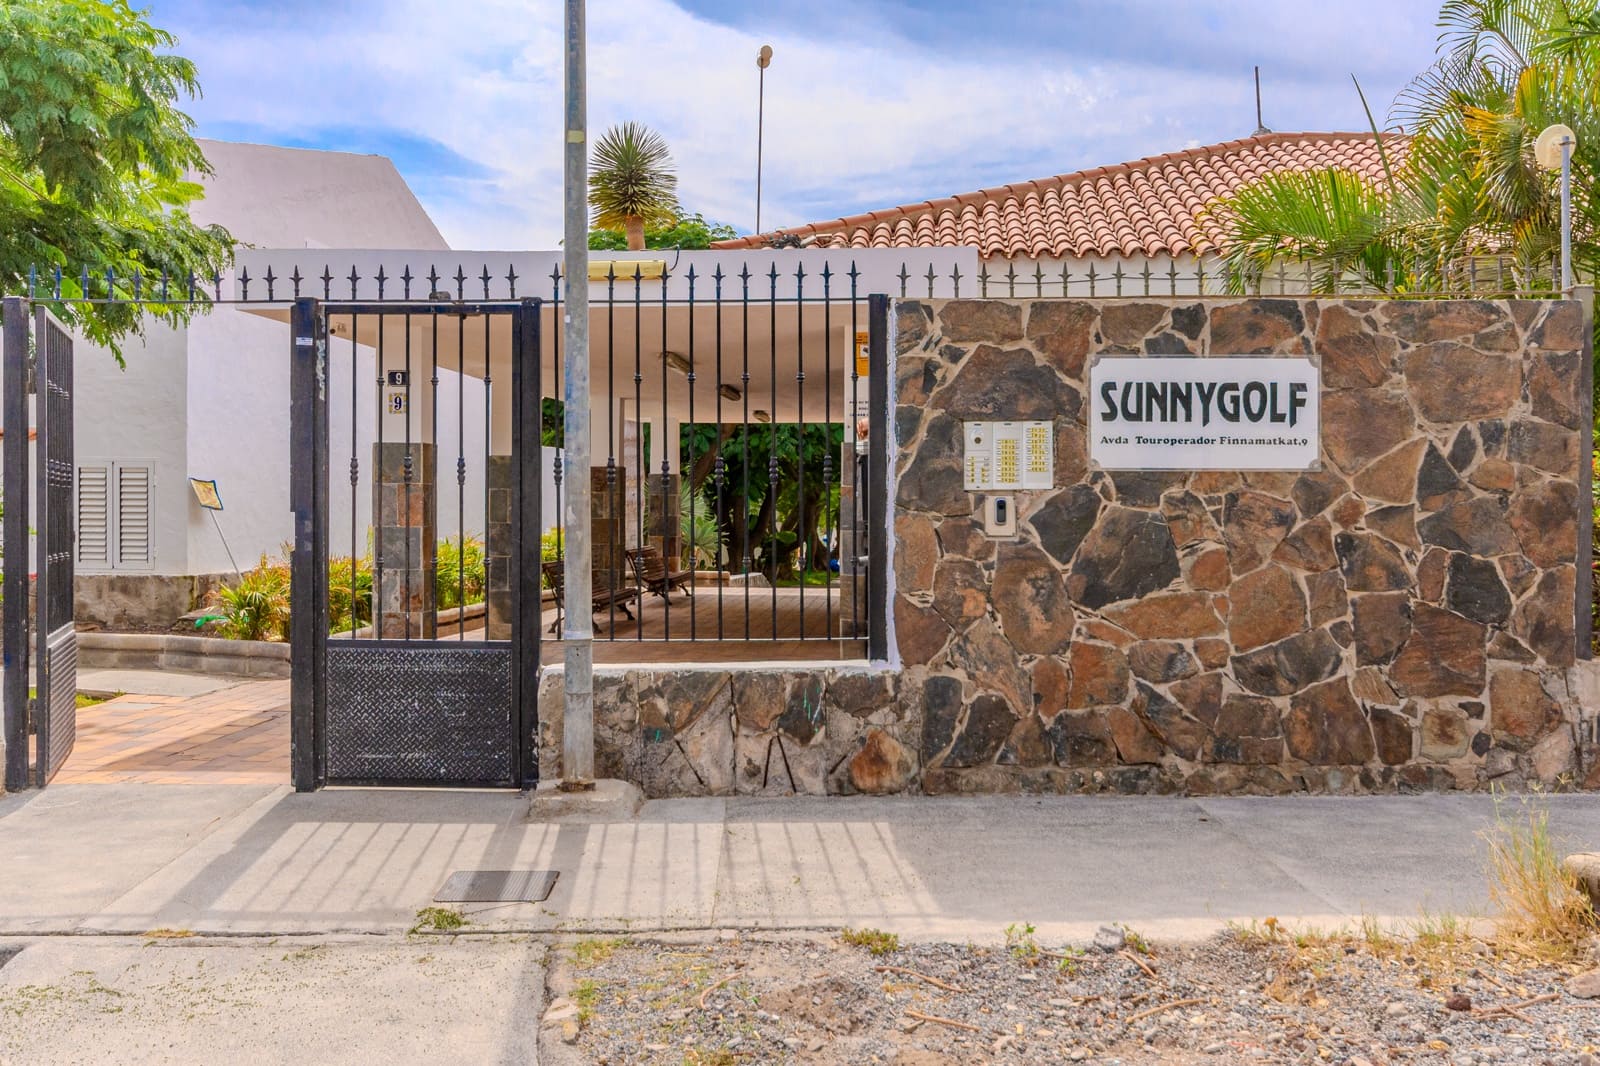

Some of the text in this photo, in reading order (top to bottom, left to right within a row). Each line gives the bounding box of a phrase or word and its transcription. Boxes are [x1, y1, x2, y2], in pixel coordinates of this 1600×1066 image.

[395, 372, 403, 385] 9
[394, 396, 402, 410] 9
[1100, 381, 1308, 428] SUNNYGOLF
[1100, 436, 1129, 445] Avda
[1135, 436, 1217, 446] Touroperador
